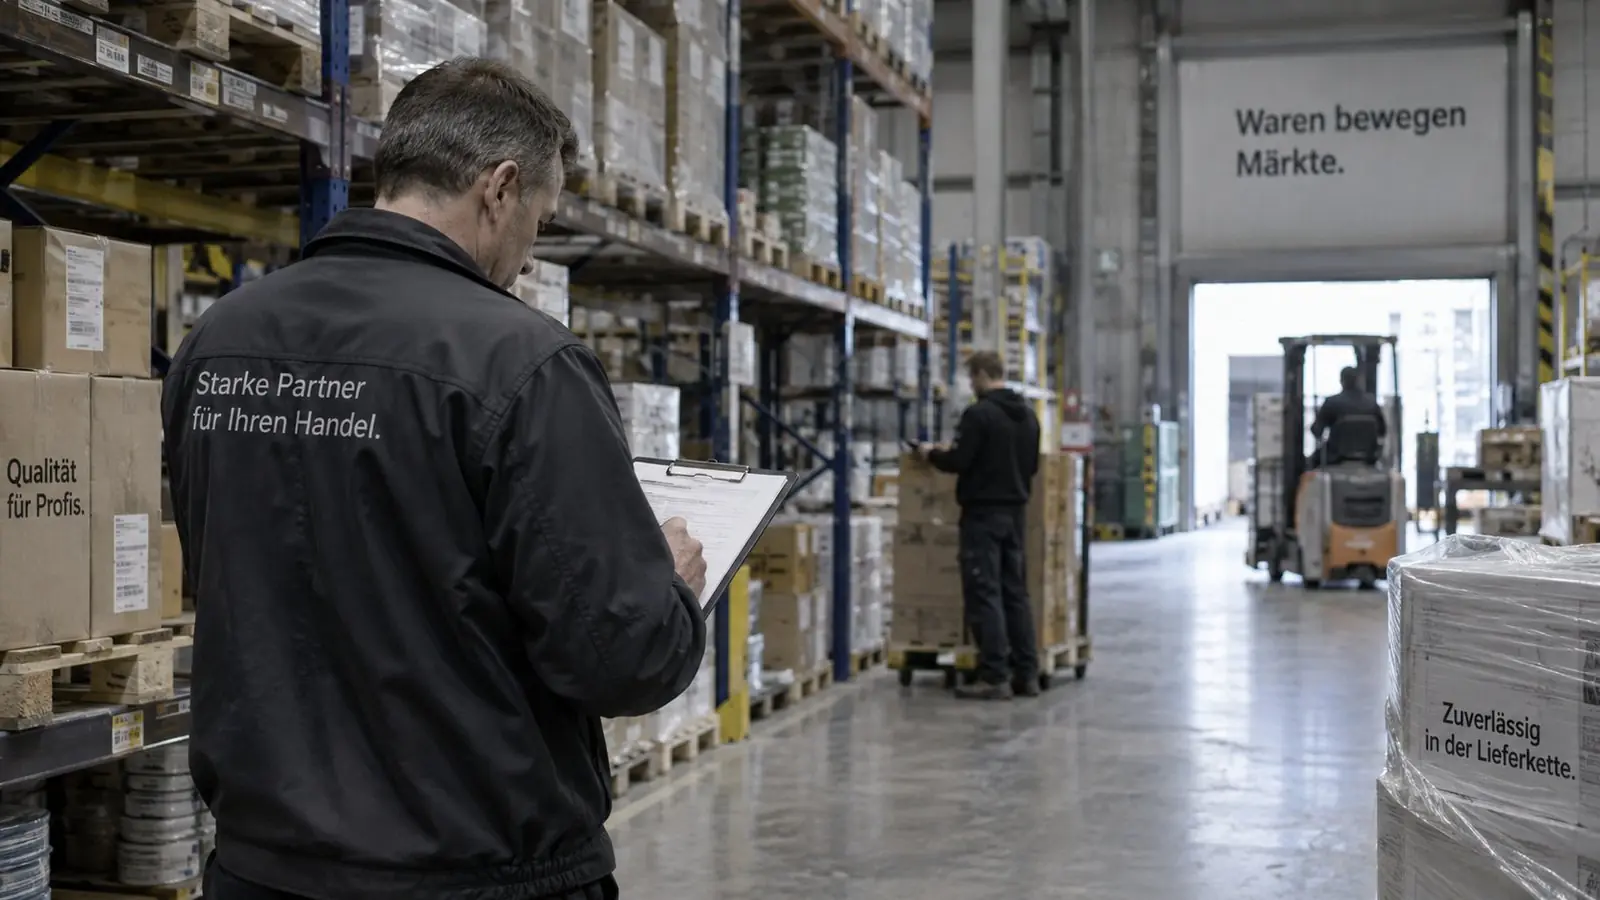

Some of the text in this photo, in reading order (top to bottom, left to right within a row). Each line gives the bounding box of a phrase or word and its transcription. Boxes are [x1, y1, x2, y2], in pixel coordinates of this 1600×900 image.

[1235, 104, 1467, 137] Waren bewegen
[1236, 148, 1345, 178] Märkte.
[196, 370, 367, 400] Starke Partner
[192, 405, 381, 440] für Ihren Handel.
[7, 458, 77, 488] Qualität
[7, 492, 85, 519] für Profis.
[1442, 701, 1541, 746] Zuverlässig
[1424, 728, 1576, 780] in der Lieferkette.
